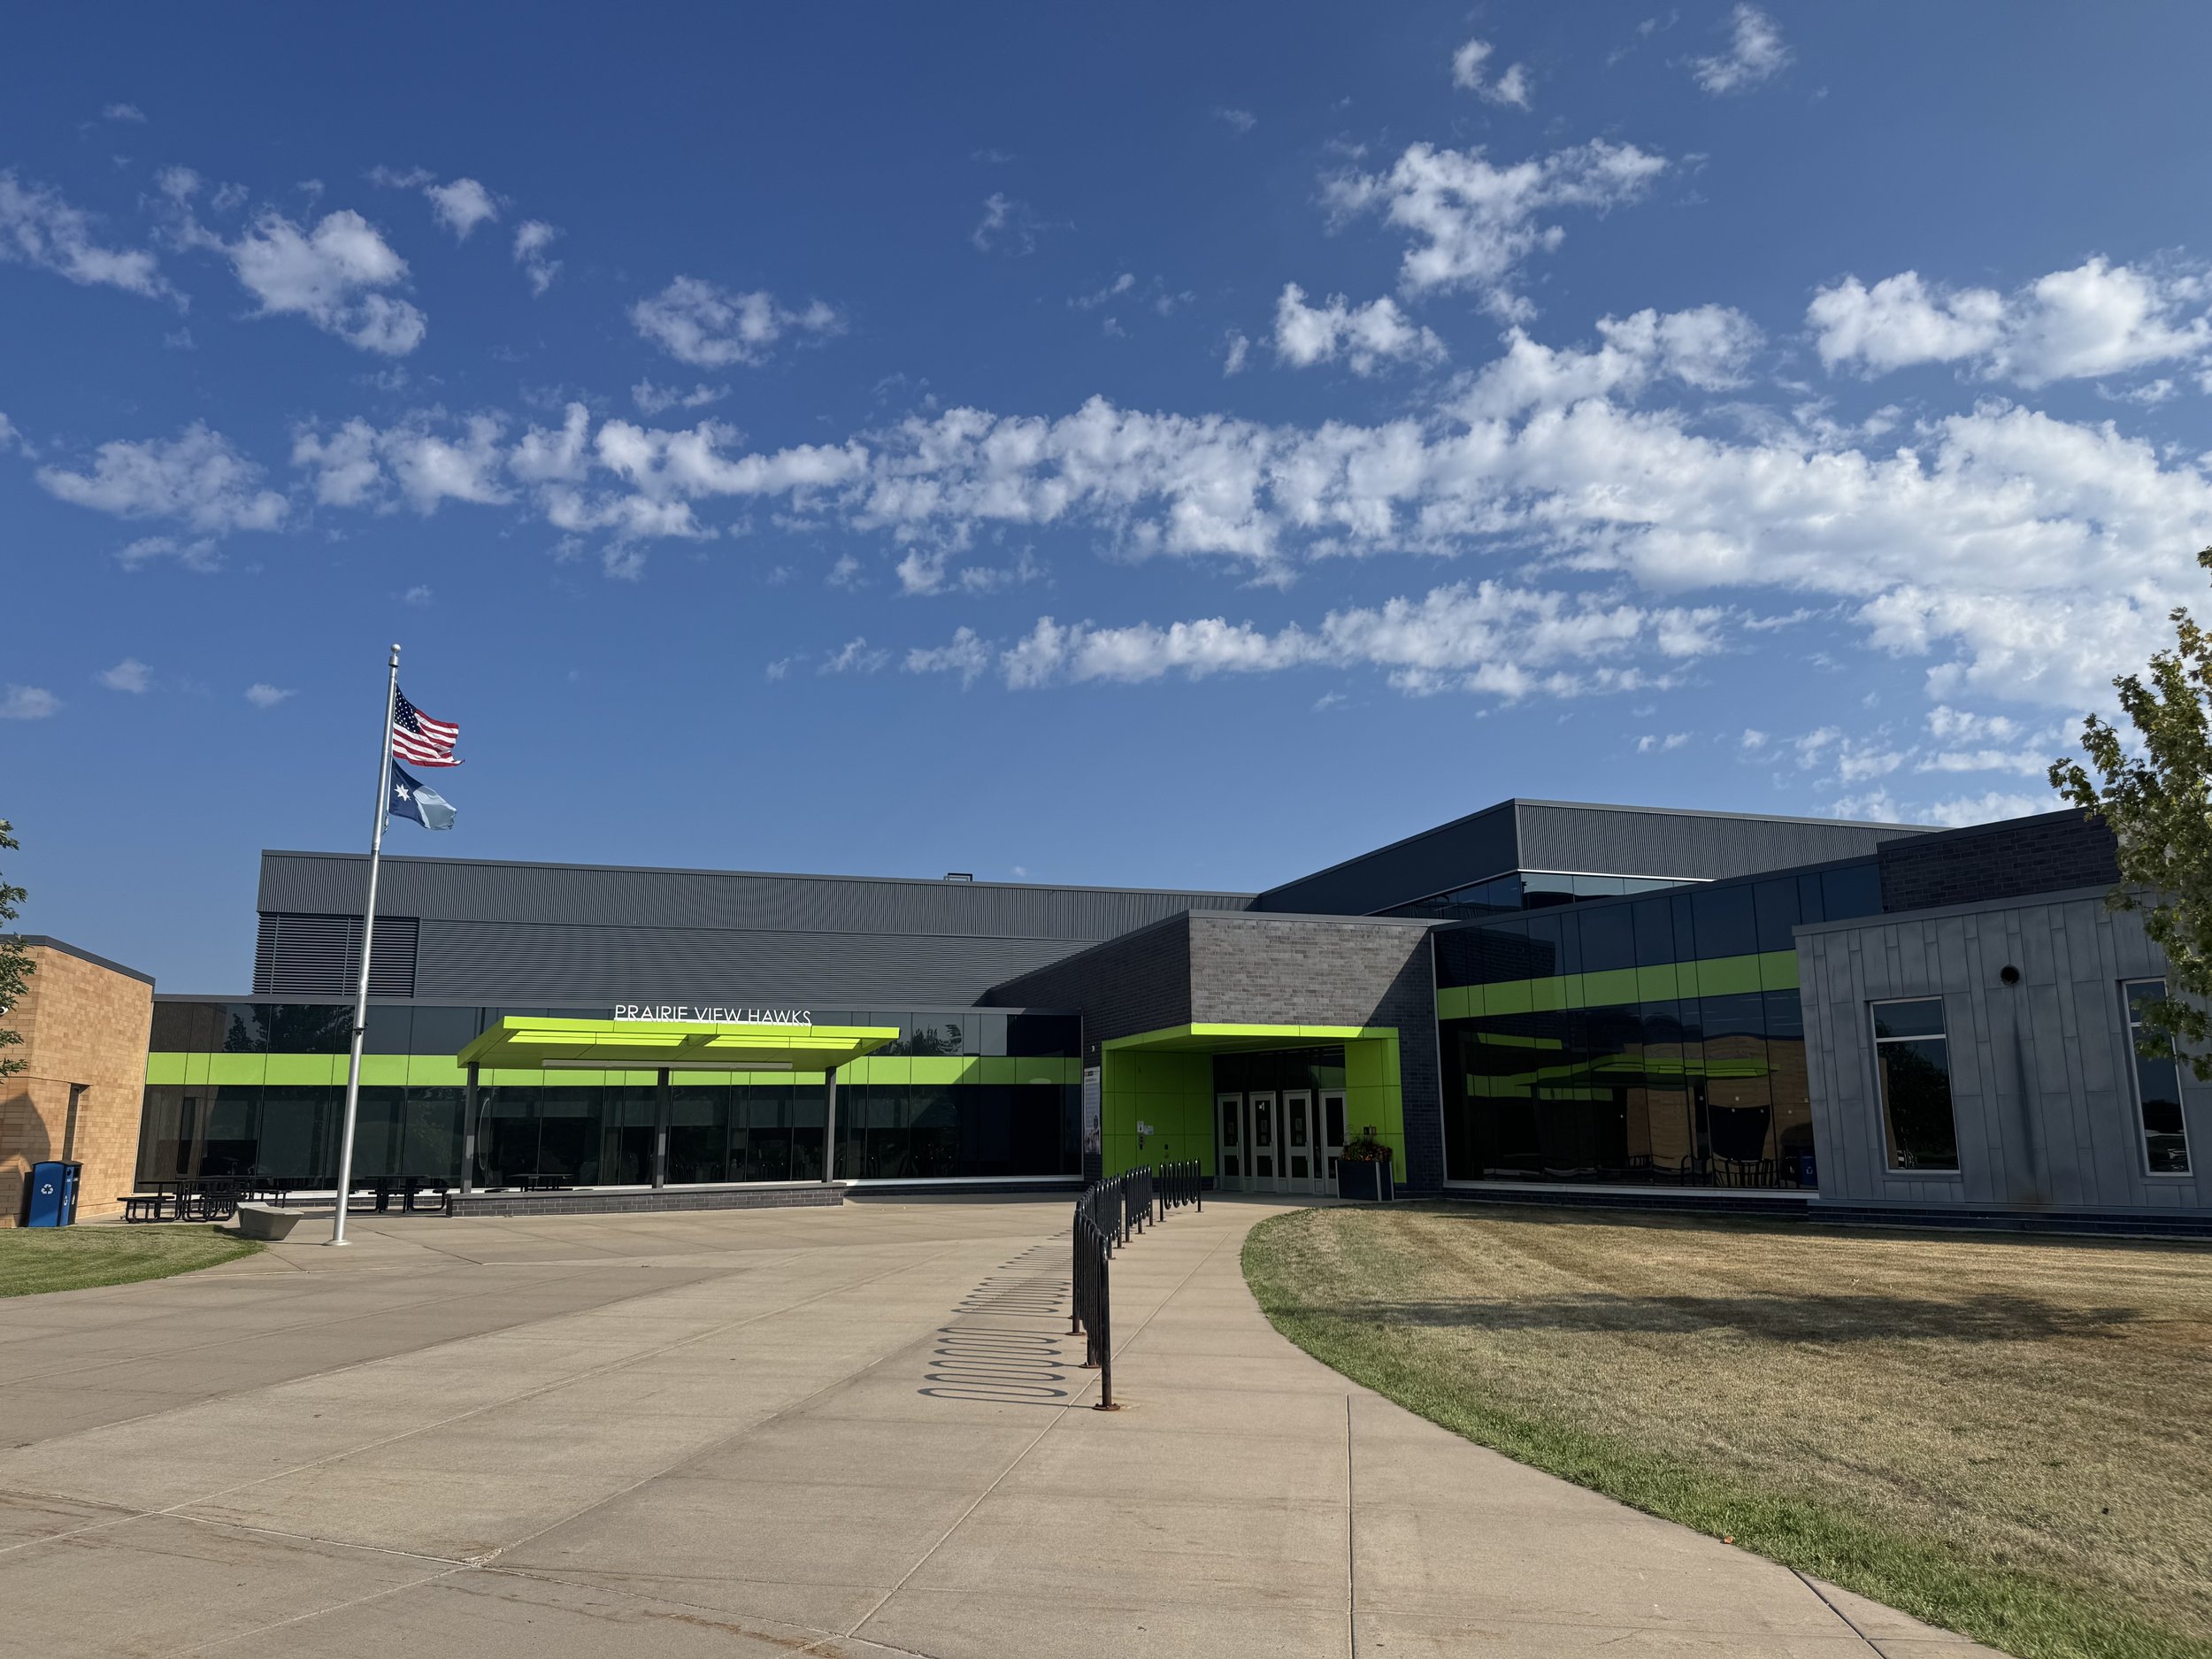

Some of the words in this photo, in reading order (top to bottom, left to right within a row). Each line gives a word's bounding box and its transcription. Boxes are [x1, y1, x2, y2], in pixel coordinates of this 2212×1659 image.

[614, 1004, 688, 1021] PRAIRIE
[695, 1007, 741, 1023] VIEW
[749, 1009, 811, 1025] HAWKS
